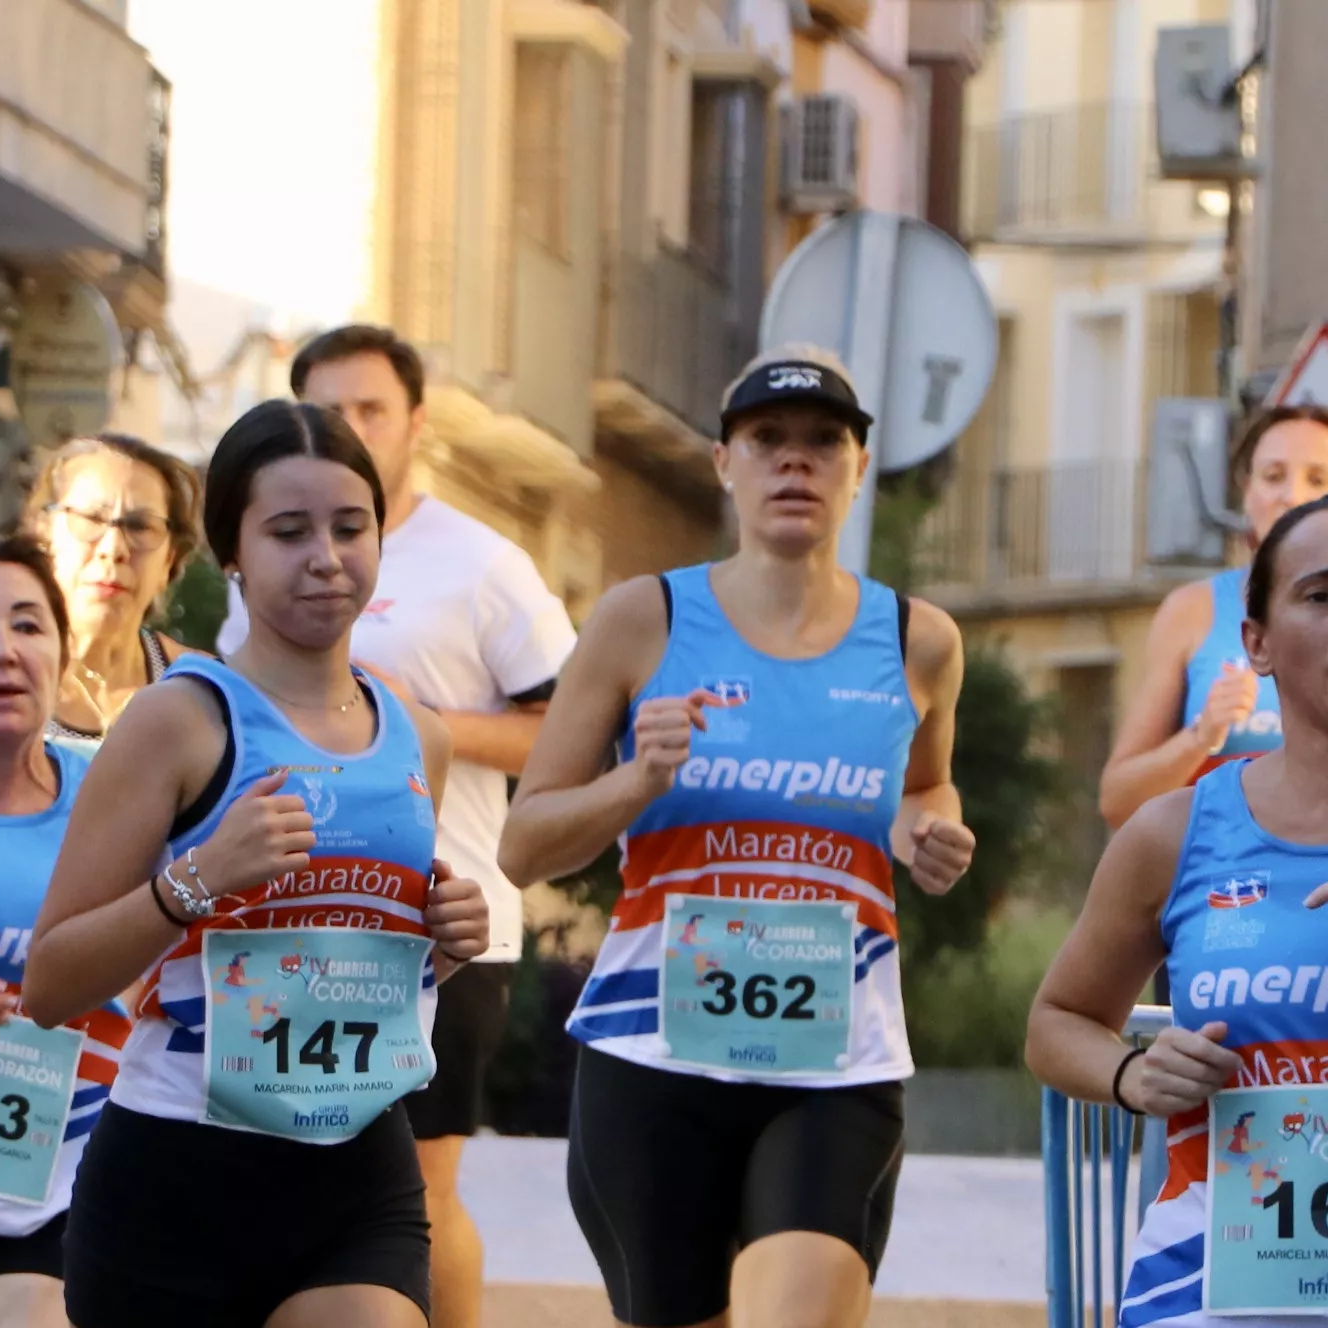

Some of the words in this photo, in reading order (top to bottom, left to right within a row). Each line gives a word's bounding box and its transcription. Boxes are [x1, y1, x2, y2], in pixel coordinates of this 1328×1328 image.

[680, 756, 886, 800] enerplus
[705, 826, 853, 870] Maratón
[266, 862, 403, 899] Maratón
[310, 957, 331, 975] IV
[329, 960, 379, 977] CARRERA
[702, 971, 817, 1021] 362
[262, 1017, 380, 1075] 147
[254, 1083, 312, 1095] MACARENA
[314, 1082, 350, 1094] MARIN
[353, 1080, 394, 1091] AMARO
[293, 1110, 349, 1127] Infrico
[318, 1105, 349, 1114] GRUPO
[1257, 1249, 1311, 1260] MARICELI
